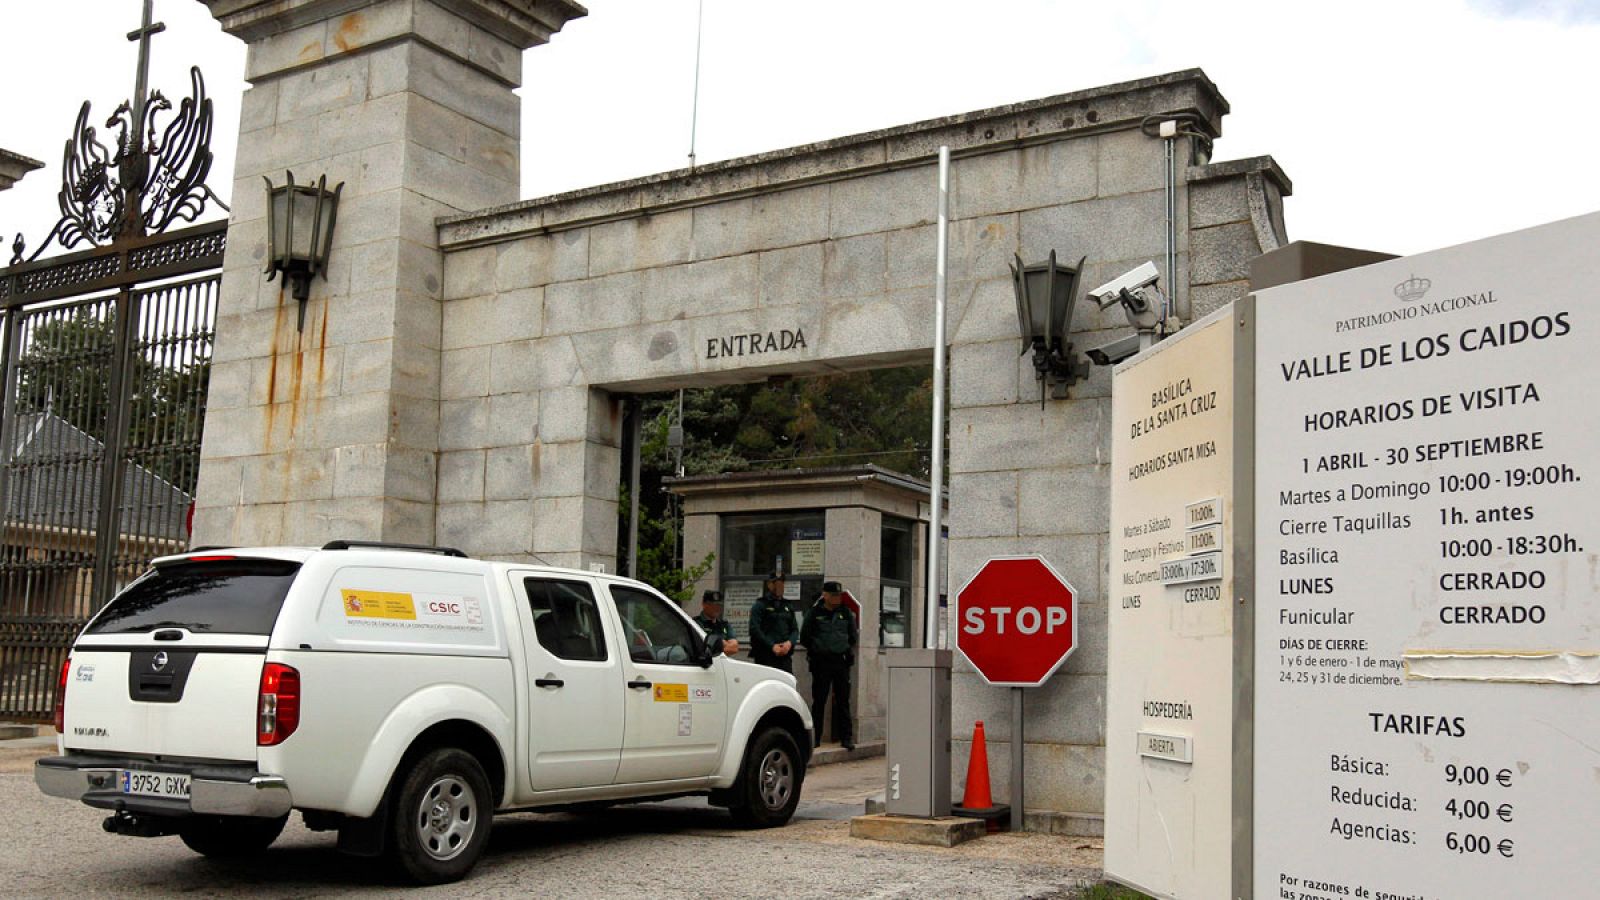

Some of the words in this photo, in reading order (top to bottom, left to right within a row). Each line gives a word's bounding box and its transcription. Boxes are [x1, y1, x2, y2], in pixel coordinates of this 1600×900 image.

[1335, 306, 1417, 333] PATRIMONIO
[1420, 291, 1497, 317] NACIONAL
[706, 328, 807, 359] ENTRADA
[1281, 351, 1351, 382] VALLE
[1360, 344, 1392, 369] DE
[1401, 333, 1450, 362] LOS
[1459, 311, 1571, 351] CAIDOS
[1151, 378, 1192, 408] BASÍLICA
[1131, 421, 1141, 439] DE
[1143, 416, 1155, 434] LA
[1157, 402, 1188, 428] SANTA
[1190, 391, 1217, 416] CRUZ
[1304, 400, 1413, 433] HORARIOS
[1422, 395, 1451, 417] DE
[1459, 382, 1540, 411] VISITA
[1129, 454, 1166, 481] HORARIOS
[1167, 446, 1194, 468] SANTA
[1196, 440, 1217, 459] MISA
[1302, 458, 1309, 473] 1
[1316, 452, 1368, 472] ABRIL
[1386, 447, 1409, 465] 30
[1415, 432, 1544, 463] SEPTIEMBRE
[1279, 488, 1331, 506] Martes
[1336, 489, 1346, 502] a
[1351, 480, 1430, 502] Domingo
[1439, 472, 1490, 493] 10:00
[1505, 463, 1581, 488] 19:00h.
[1279, 518, 1327, 536] Cierre
[1333, 512, 1411, 534] Taquillas
[1439, 507, 1469, 526] 1h.
[1475, 505, 1534, 524] antes
[1279, 547, 1339, 566] Basílica
[1440, 538, 1492, 558] 10:00
[1506, 533, 1584, 556] 18:30h.
[1135, 568, 1160, 584] Conventu
[1279, 577, 1333, 595] LUNES
[1439, 570, 1546, 591] CERRADO
[429, 602, 460, 614] CSIC
[1122, 595, 1141, 609] LUNES
[1184, 585, 1221, 603] CERRADO
[963, 606, 1067, 634] STOP
[1279, 607, 1354, 625] Funicular
[1439, 605, 1546, 624] CERRADO
[1280, 637, 1304, 650] DÍAS
[1308, 639, 1322, 650] DE
[1325, 639, 1368, 651] CIERRE:
[1280, 655, 1285, 666] 1
[1287, 658, 1294, 668] y
[1296, 655, 1302, 666] 6
[1305, 655, 1317, 666] de
[1319, 658, 1348, 667] enero
[1356, 656, 1361, 667] 1
[1363, 657, 1376, 668] de
[1279, 671, 1294, 684] 24,
[1297, 671, 1309, 683] 25
[1311, 675, 1318, 685] y
[1320, 672, 1331, 684] 31
[1333, 672, 1346, 684] de
[1348, 673, 1403, 686] diciembre.
[695, 689, 712, 697] CSIC
[1143, 699, 1193, 720] HOSPEDERÍA
[1369, 712, 1466, 737] TARIFAS
[1148, 738, 1175, 755] ABIERTA
[1330, 754, 1389, 776] Básica:
[1445, 764, 1489, 786] 9,00
[1496, 768, 1513, 787] €
[133, 775, 161, 792] 3752
[166, 776, 187, 795] GXK
[1330, 786, 1417, 812] Reducida:
[1444, 798, 1490, 820] 4,00
[1496, 803, 1513, 822] €
[1330, 817, 1417, 845] Agencias:
[1446, 832, 1491, 854] 6,00
[1497, 838, 1514, 857] €
[1279, 887, 1296, 900] las
[1280, 873, 1299, 886] Por
[1303, 878, 1350, 896] razones
[1355, 885, 1369, 899] de
